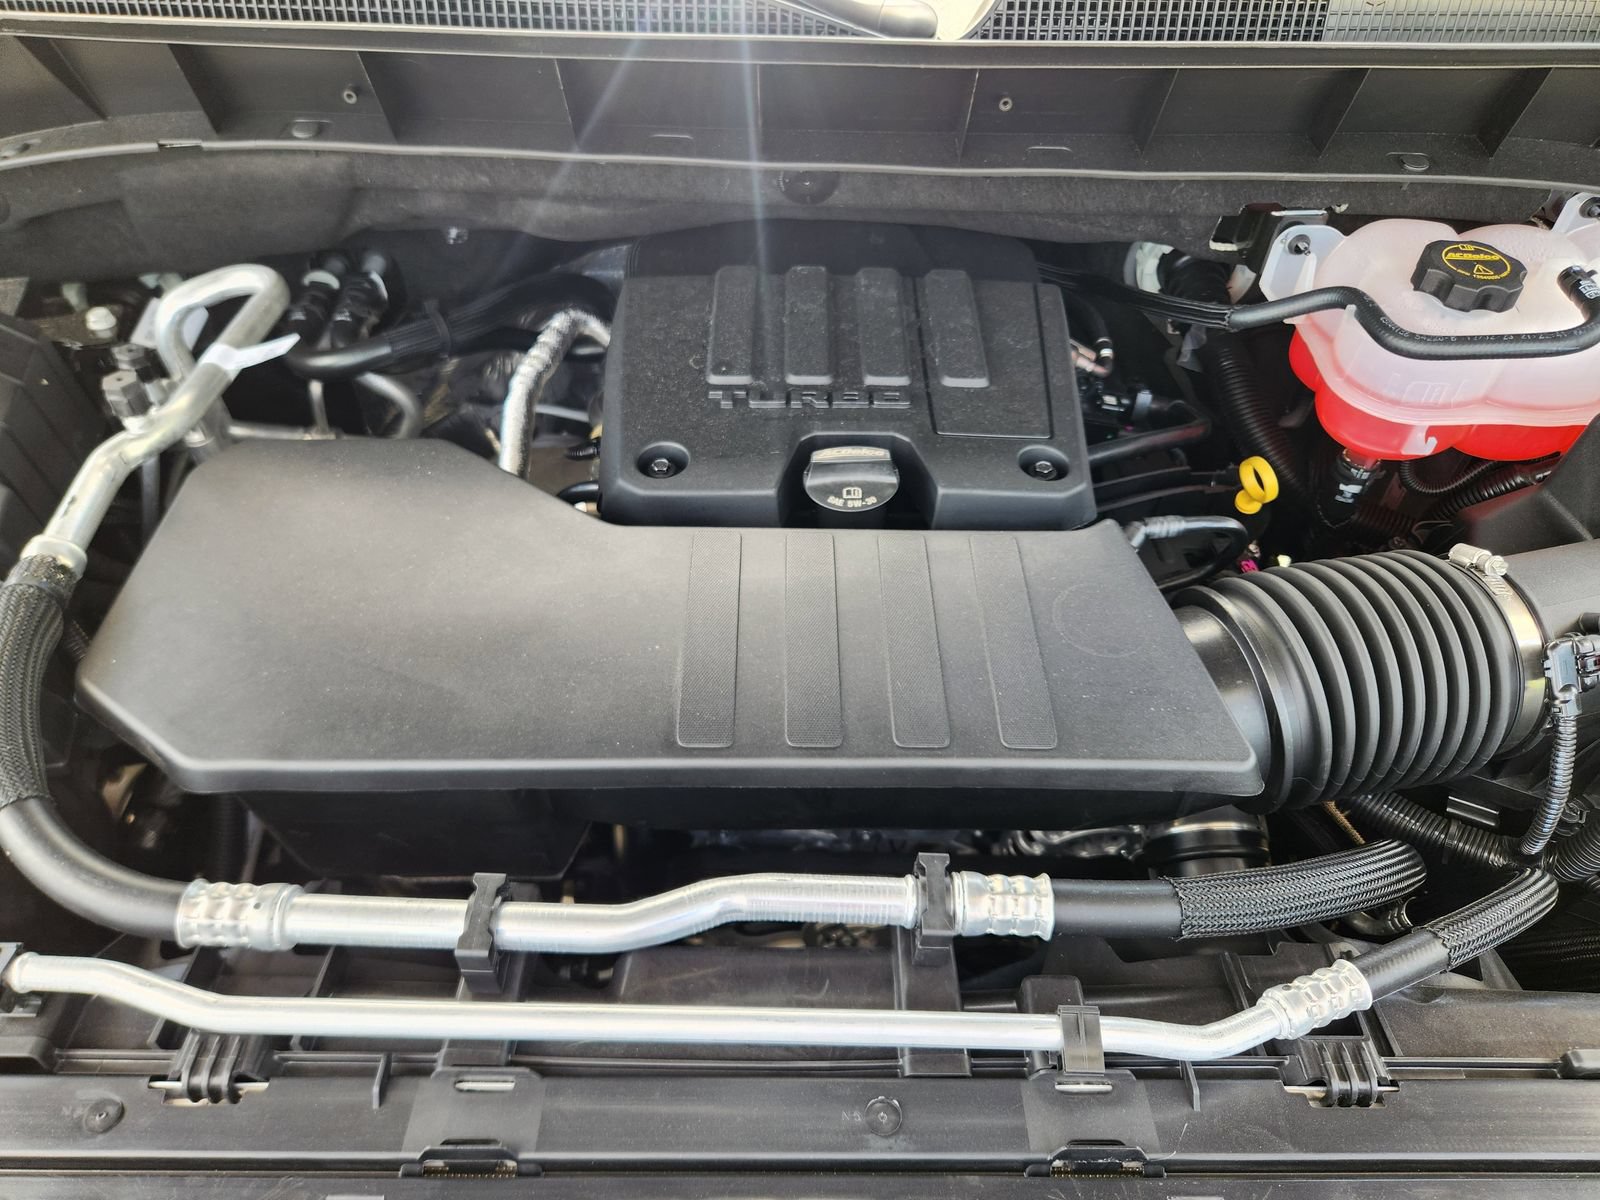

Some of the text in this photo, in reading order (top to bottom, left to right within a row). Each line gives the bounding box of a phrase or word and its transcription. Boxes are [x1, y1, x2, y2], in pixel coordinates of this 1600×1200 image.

[1445, 252, 1500, 261] ACDelco
[707, 390, 911, 409] TURBO
[827, 495, 878, 508] SAE 5W-30
